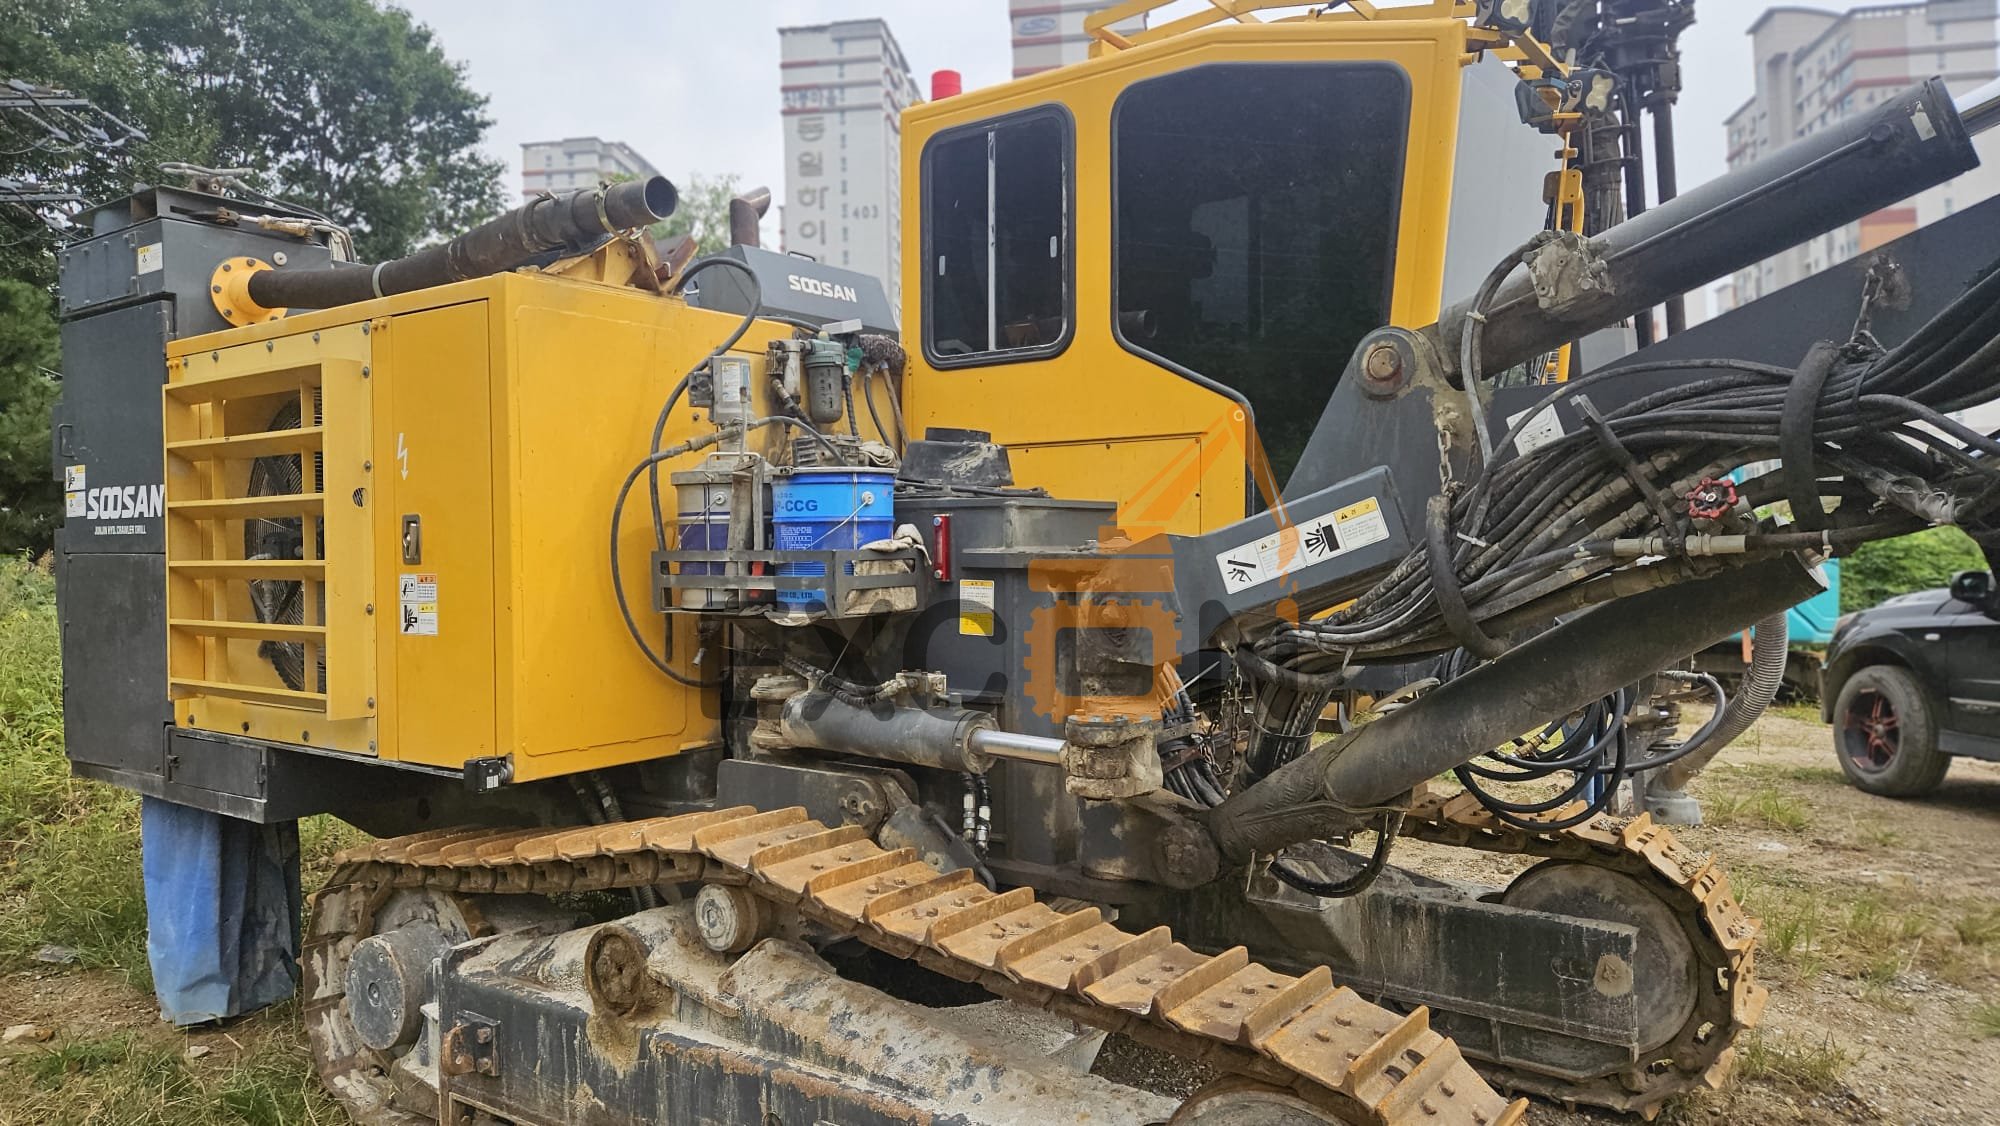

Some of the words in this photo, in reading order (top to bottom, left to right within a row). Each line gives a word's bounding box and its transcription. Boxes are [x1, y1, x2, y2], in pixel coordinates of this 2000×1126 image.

[852, 204, 879, 220] 403
[788, 274, 857, 303] SOOSAN
[87, 484, 165, 520] SOOSAN
